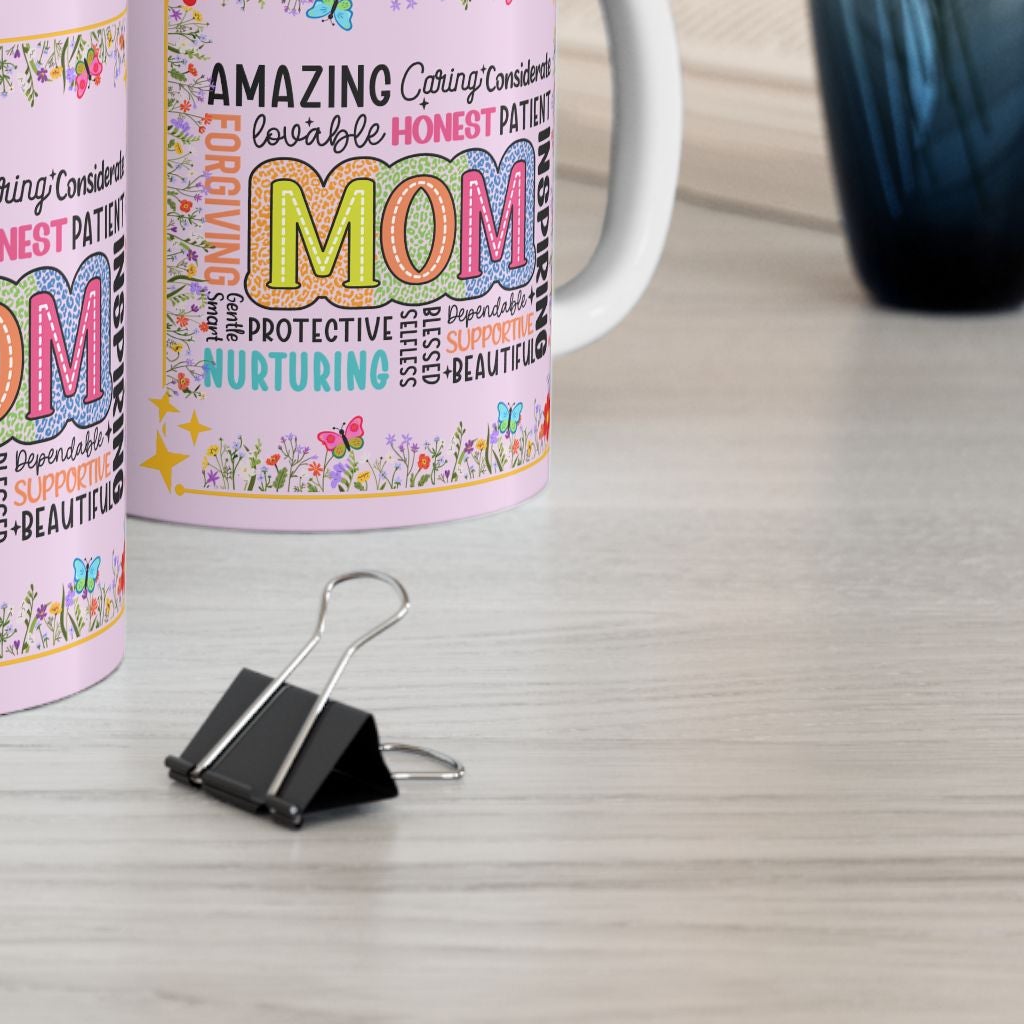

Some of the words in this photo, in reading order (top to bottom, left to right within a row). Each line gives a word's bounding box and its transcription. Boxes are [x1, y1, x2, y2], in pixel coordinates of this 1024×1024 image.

[207, 62, 391, 108] AMAZING
[400, 61, 483, 104] Caring
[252, 113, 386, 154] lovable
[391, 107, 496, 146] HONEST
[500, 90, 551, 135] PATIENT
[72, 192, 125, 250] PATIENT
[203, 113, 242, 287] FORGIVING
[266, 159, 527, 289] MOM
[535, 126, 551, 360] INSPIRING
[206, 292, 224, 343] Smart
[226, 292, 245, 342] Gentle
[248, 316, 393, 343] PROTECTIVE
[446, 312, 535, 353] SUPPORTIVE
[447, 289, 527, 328] Dependable
[112, 234, 125, 505] INSPIRING
[203, 347, 389, 392] NURTURING
[399, 308, 417, 388] SELFLESS
[422, 306, 441, 385] BLESSED
[452, 338, 536, 384] BEAUTIFUL
[14, 450, 112, 507] SUPPORTIVE
[15, 426, 105, 476] Dependable
[21, 480, 113, 541] BEAUTIFUL
